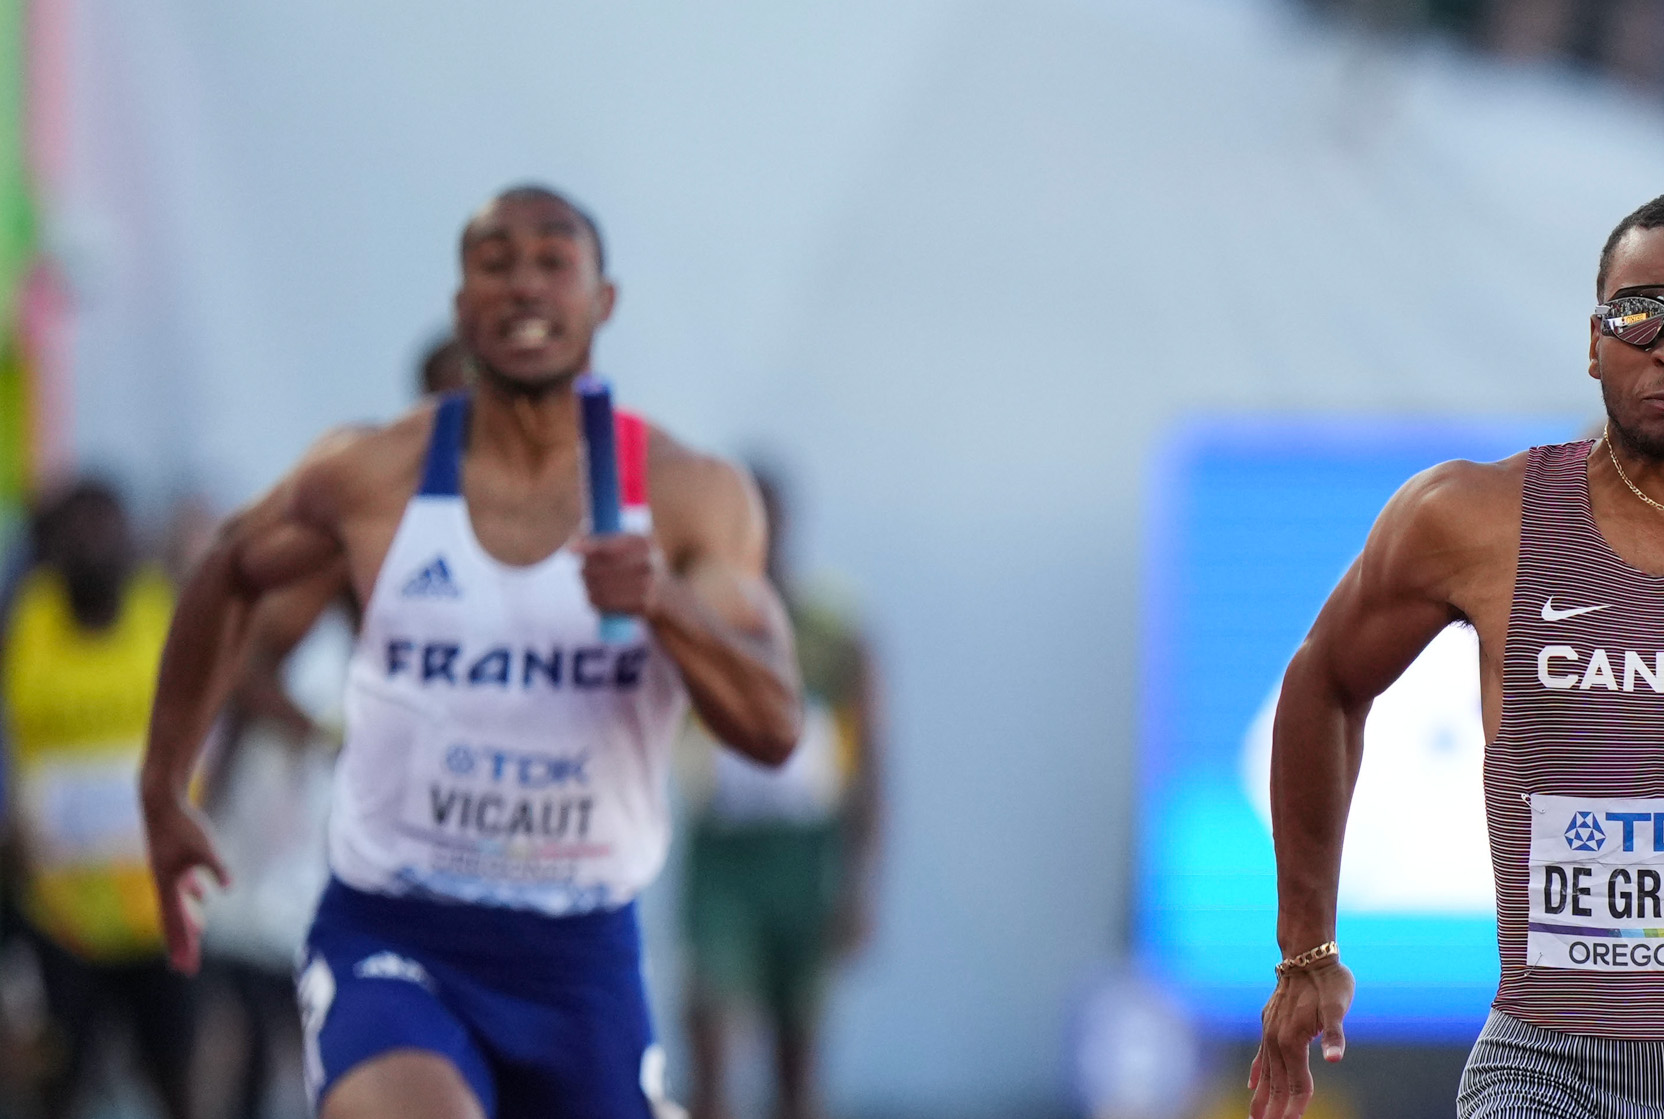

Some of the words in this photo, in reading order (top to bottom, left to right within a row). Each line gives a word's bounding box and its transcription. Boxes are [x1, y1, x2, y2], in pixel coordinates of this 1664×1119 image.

[386, 639, 650, 692] FRANCE
[481, 745, 589, 789] TDK
[429, 784, 593, 837] VICAUT
[1543, 865, 1593, 917] DE
